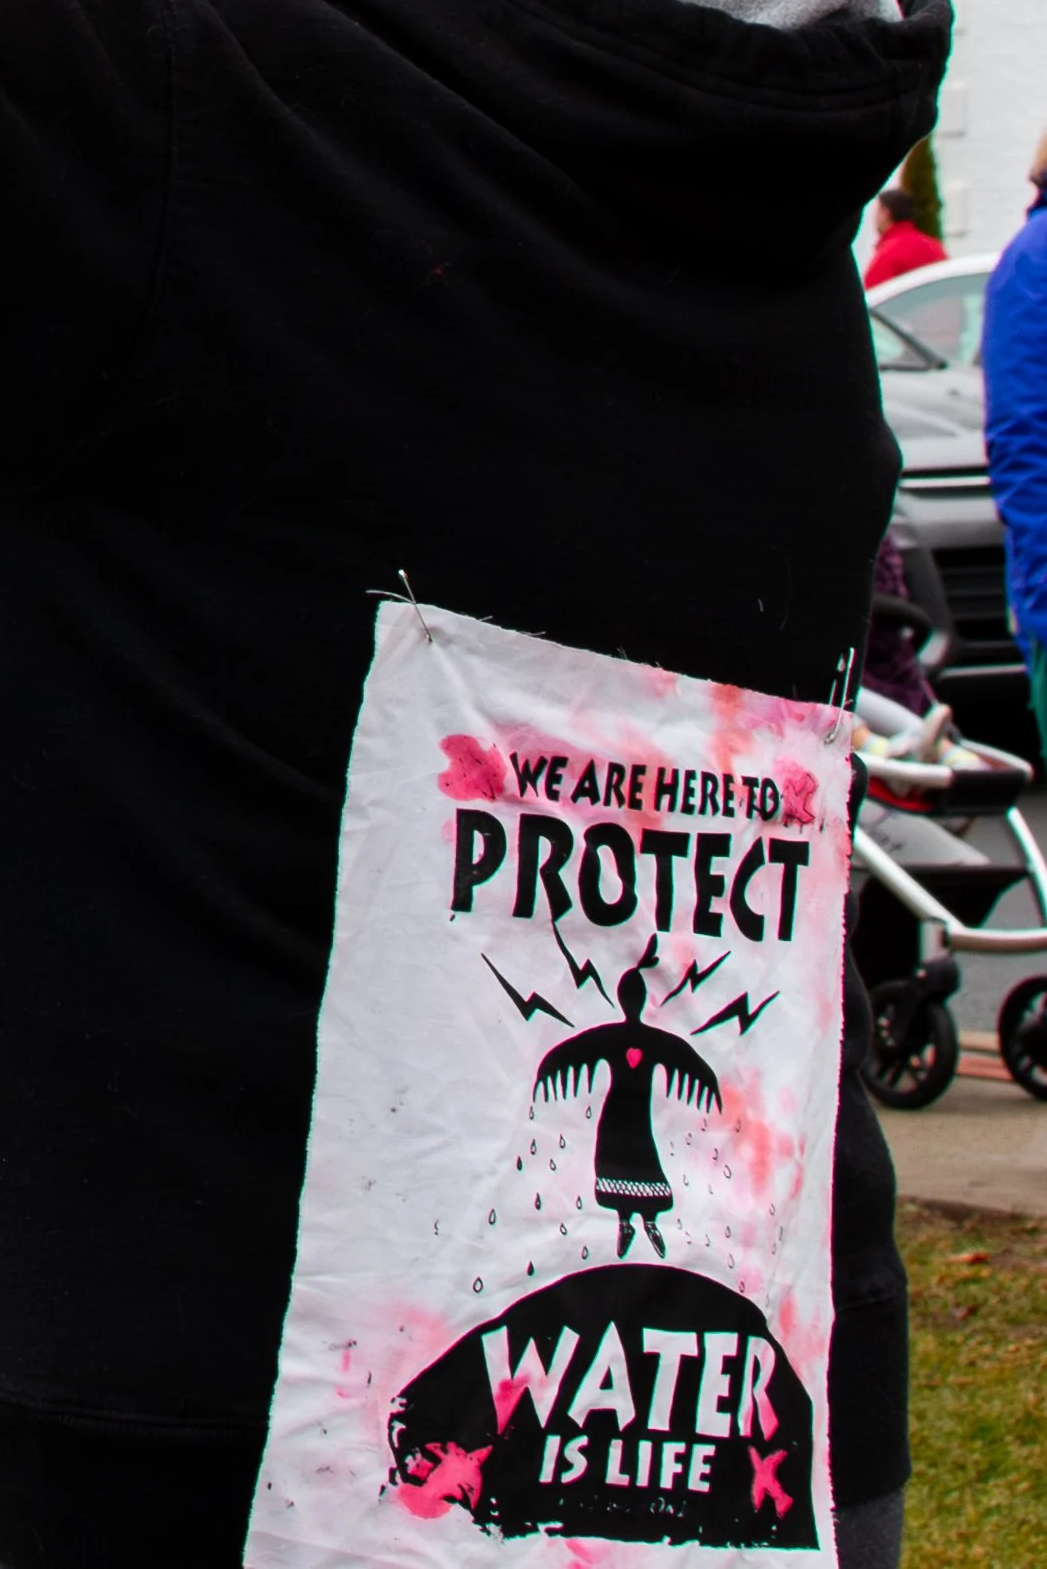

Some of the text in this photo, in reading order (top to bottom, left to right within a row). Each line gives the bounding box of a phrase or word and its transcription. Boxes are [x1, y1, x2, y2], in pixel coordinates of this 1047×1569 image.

[509, 751, 568, 803] WE
[571, 759, 647, 811] ARE
[653, 766, 736, 819] HERE
[450, 808, 810, 942] PROTECT
[481, 1320, 779, 1442] WATER
[539, 1435, 716, 1493] IS LIFE
